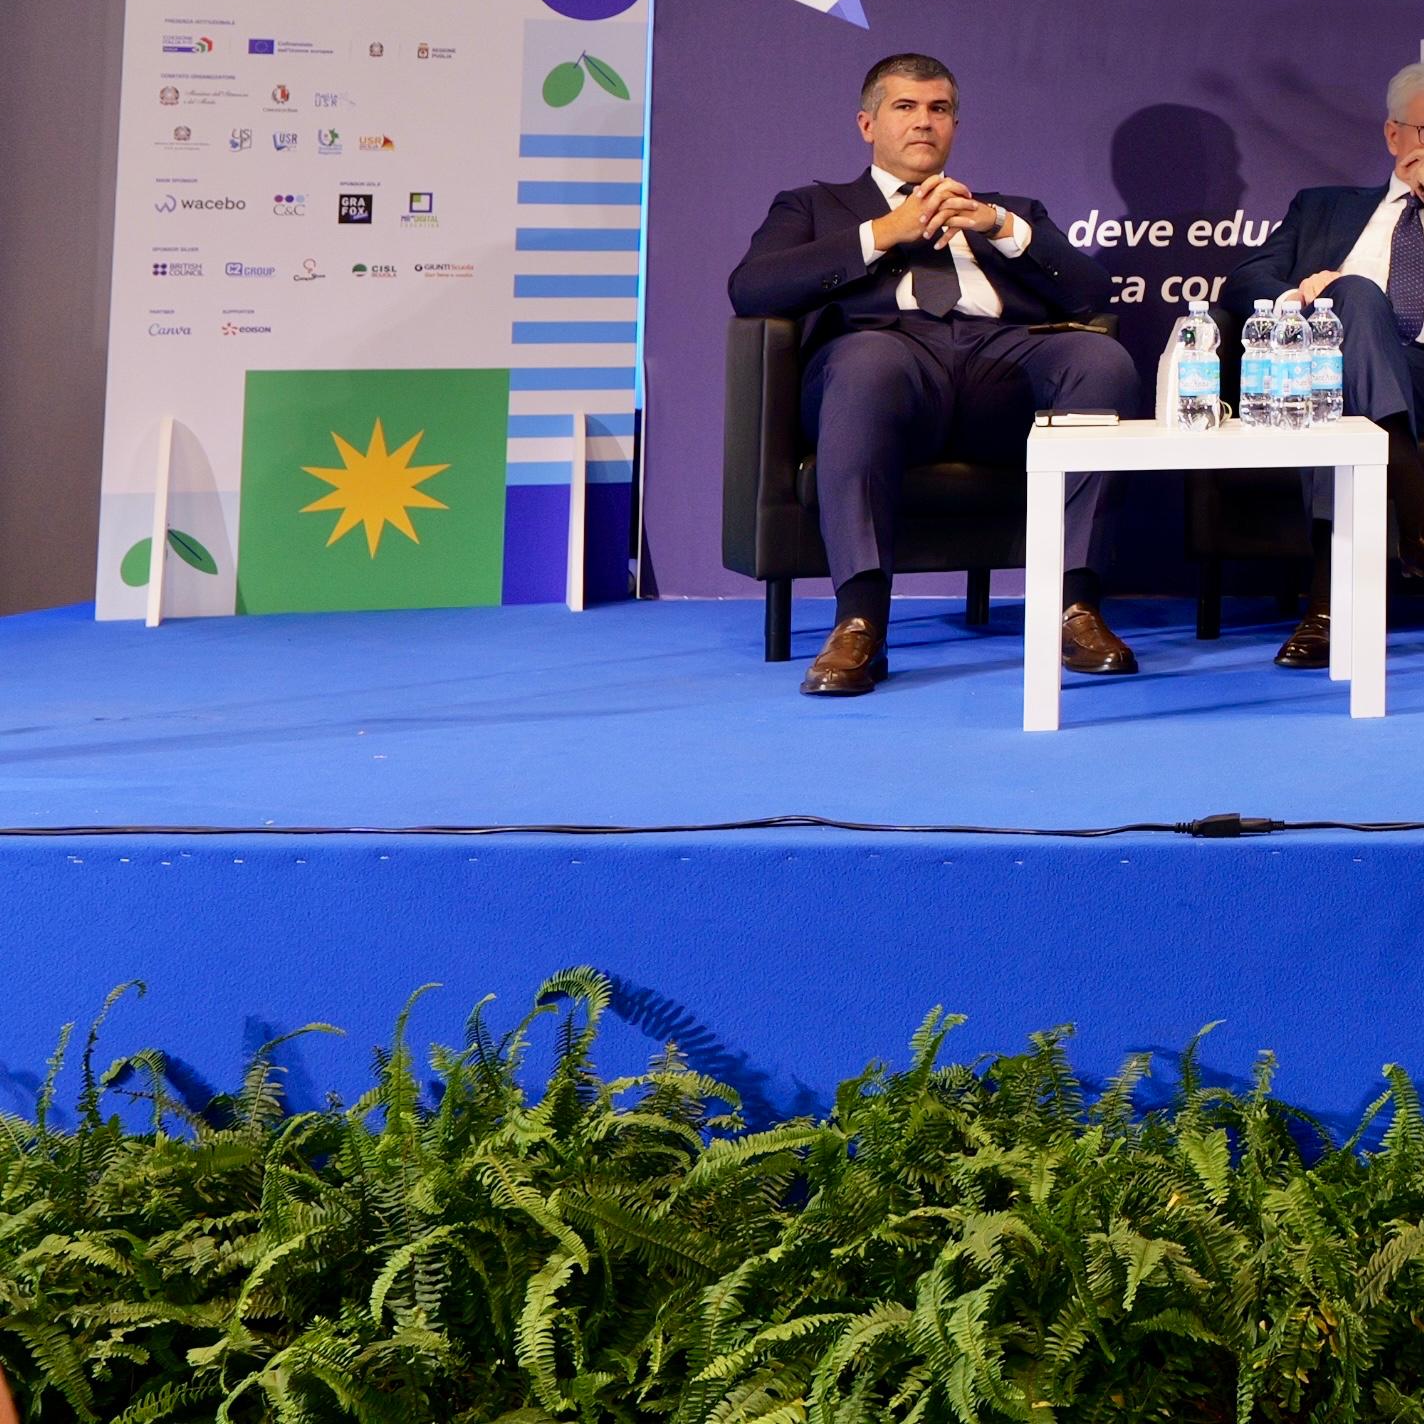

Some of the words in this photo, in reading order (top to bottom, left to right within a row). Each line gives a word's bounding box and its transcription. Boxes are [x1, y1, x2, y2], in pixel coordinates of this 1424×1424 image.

[181, 196, 246, 211] wacebo
[1068, 210, 1174, 248] deve
[1187, 210, 1283, 248] edu
[371, 265, 397, 273] CISL
[148, 323, 191, 336] Canva
